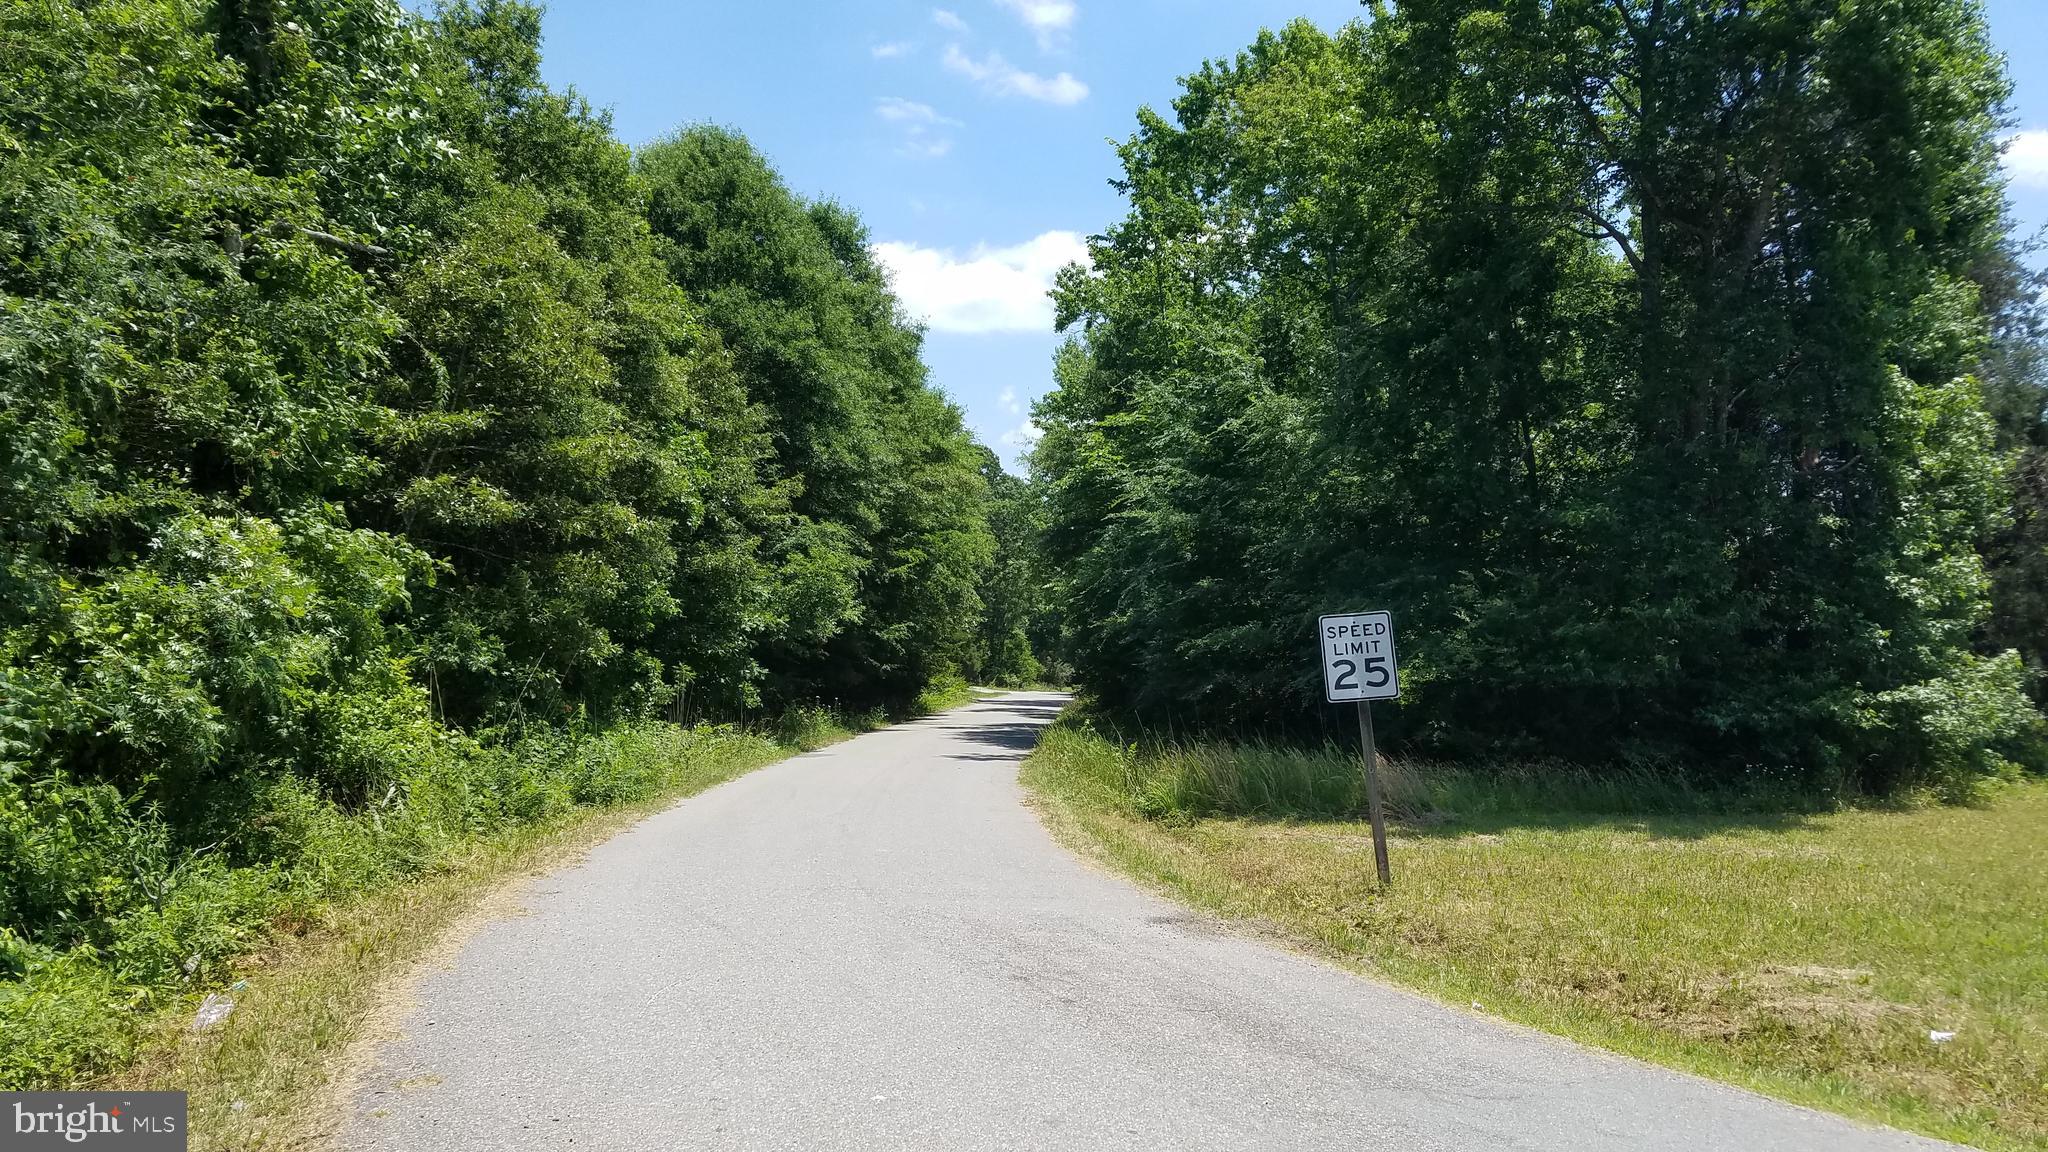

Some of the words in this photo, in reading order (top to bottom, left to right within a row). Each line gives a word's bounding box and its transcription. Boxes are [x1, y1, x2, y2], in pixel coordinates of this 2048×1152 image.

[1327, 623, 1386, 639] SPEED
[1333, 640, 1381, 656] LIMIT
[1332, 657, 1390, 691] 25
